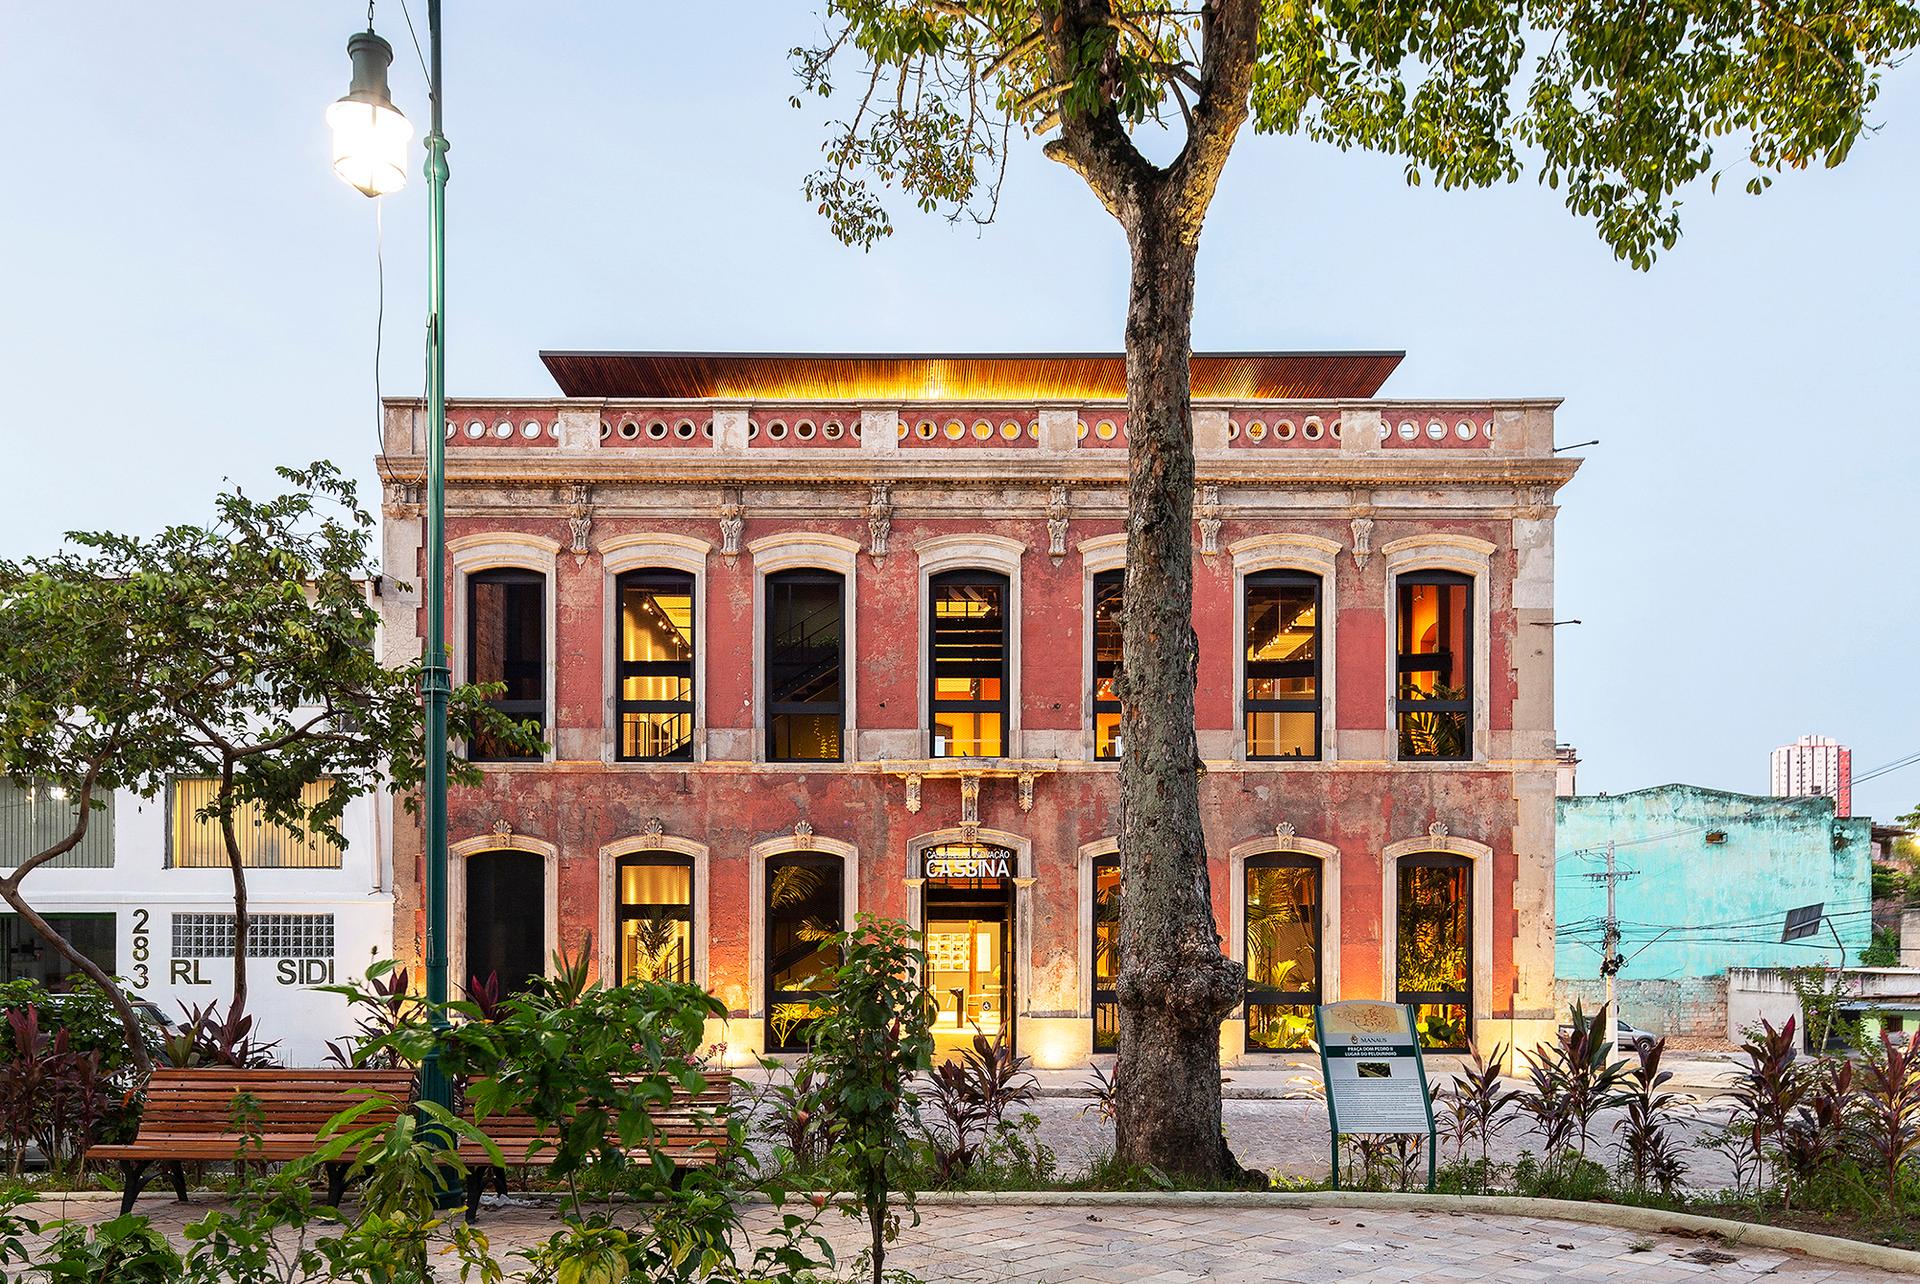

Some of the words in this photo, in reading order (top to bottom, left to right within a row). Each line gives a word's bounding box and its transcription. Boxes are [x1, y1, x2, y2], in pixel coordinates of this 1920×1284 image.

[926, 859, 1010, 878] CASSINA
[170, 959, 212, 985] RL
[276, 959, 335, 985] SIDI
